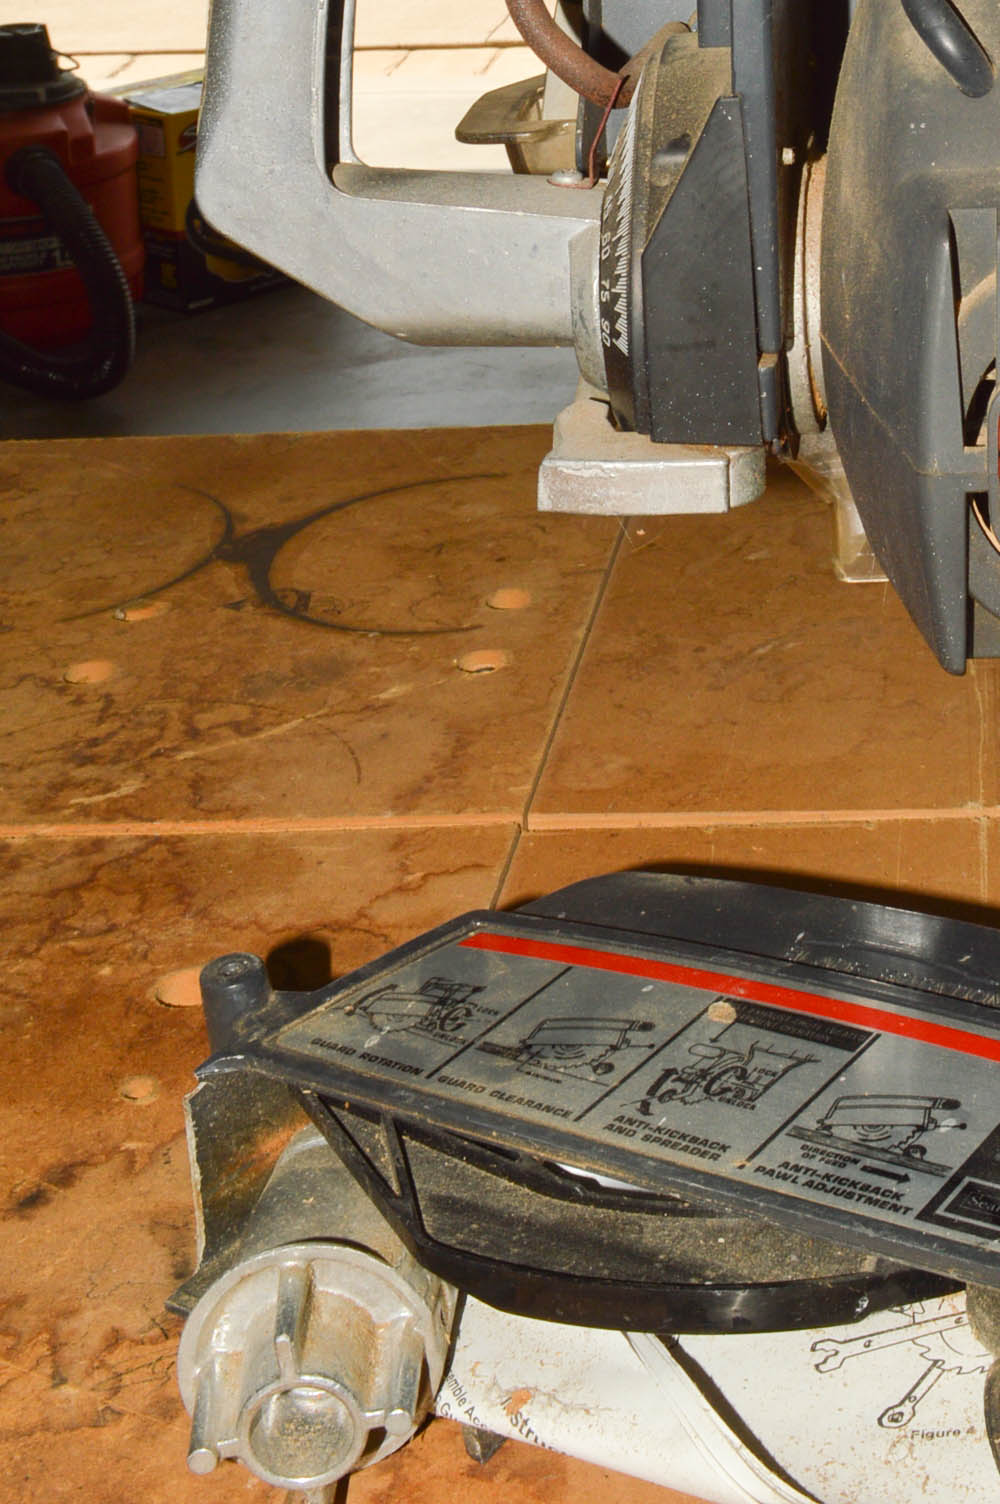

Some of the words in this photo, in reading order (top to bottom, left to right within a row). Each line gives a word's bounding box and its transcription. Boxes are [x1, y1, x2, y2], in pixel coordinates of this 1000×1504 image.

[311, 1037, 357, 1056] GUARD
[358, 1051, 424, 1076] ROTATION
[437, 1074, 487, 1094] GUARD
[489, 1090, 574, 1120] CLEARANCE
[603, 1123, 638, 1139] AND
[641, 1133, 722, 1162] SPREADER
[613, 1114, 732, 1153] ANTI-KICKBACK
[800, 1143, 862, 1165] DIRECTION
[801, 1151, 817, 1160] OF
[753, 1165, 800, 1185] PAWL
[802, 1179, 914, 1216] ADJUSTMENT
[778, 1160, 906, 1202] ANTI-KICKBACK
[910, 1428, 961, 1441] Figure
